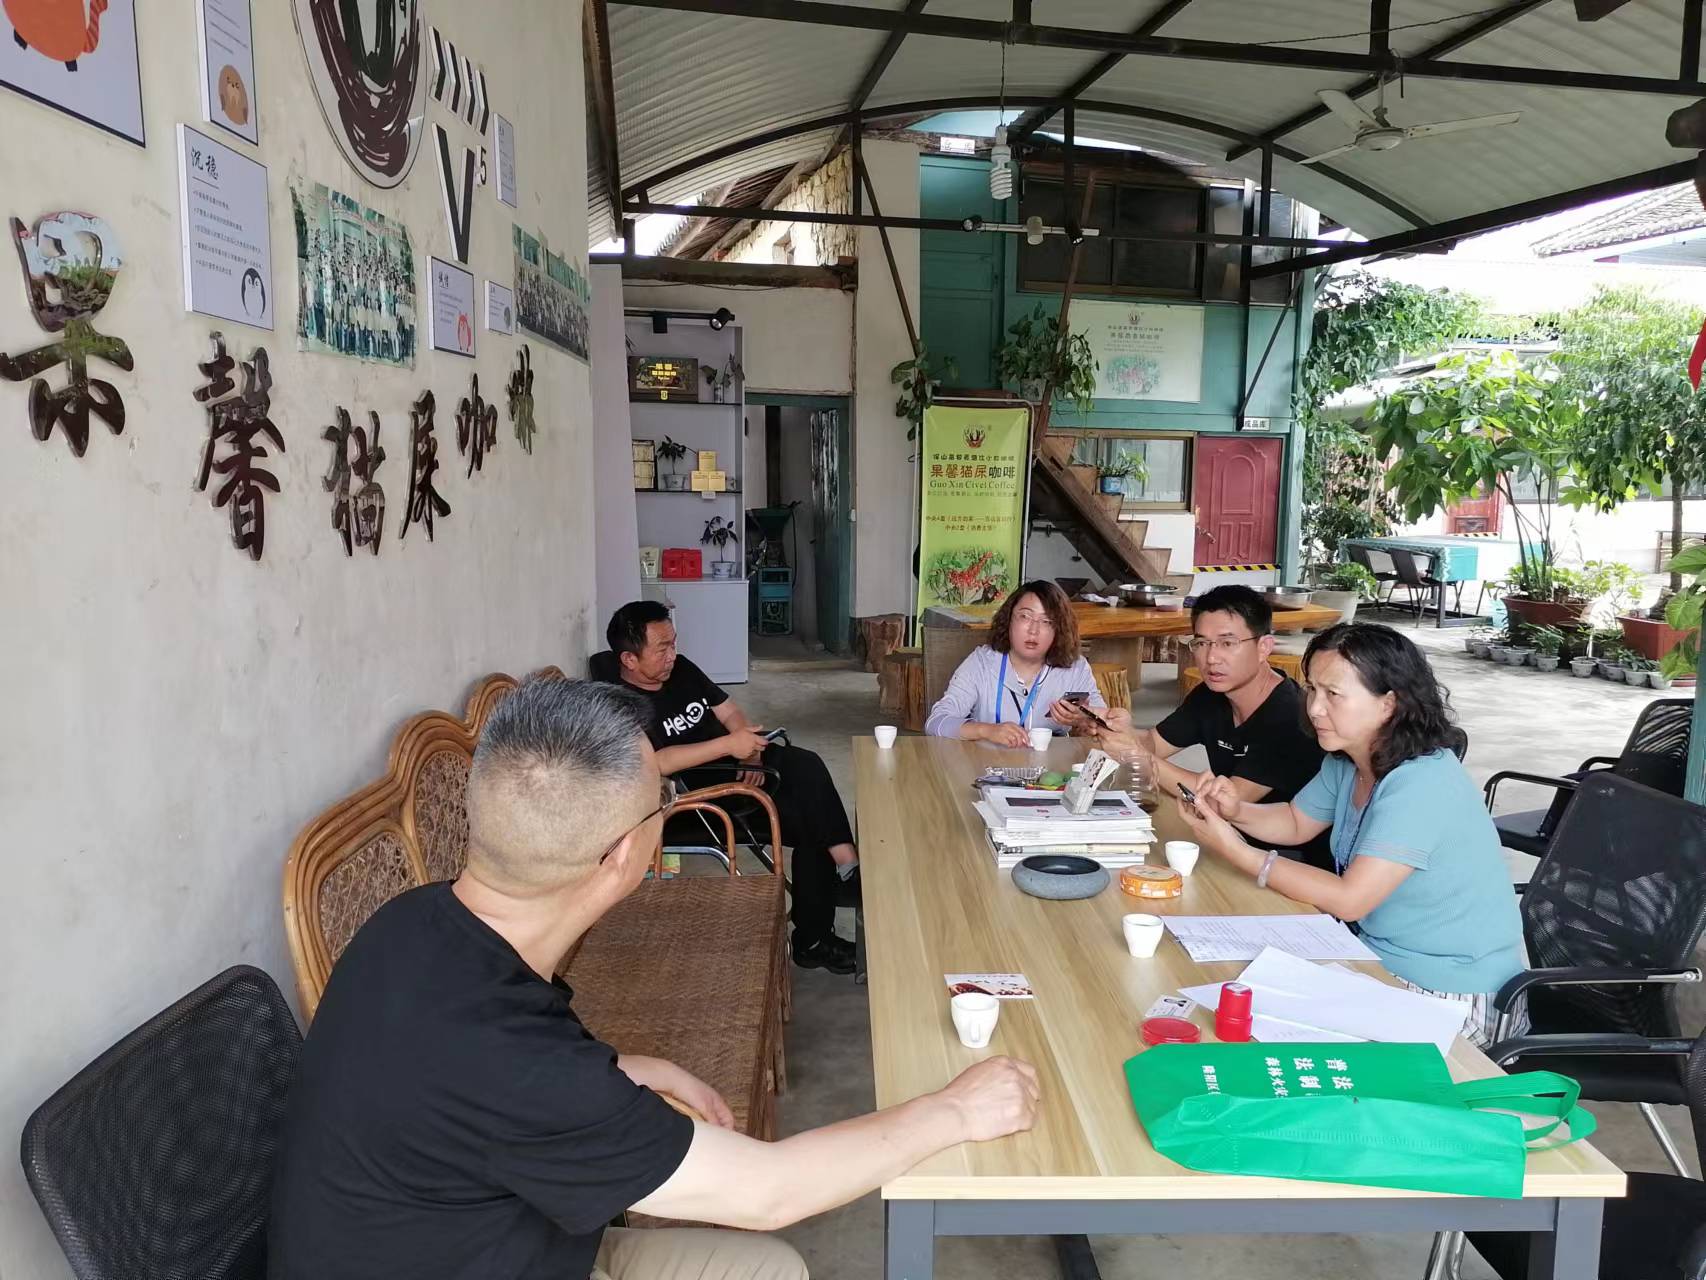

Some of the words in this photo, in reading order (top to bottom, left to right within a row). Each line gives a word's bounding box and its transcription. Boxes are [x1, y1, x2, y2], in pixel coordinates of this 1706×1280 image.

[930, 463, 1016, 480] 果馨猫屎咖啡
[929, 480, 948, 489] Guo
[948, 480, 964, 489] Xin
[1293, 1057, 1322, 1096] 法制
[1325, 1058, 1354, 1090] 普法
